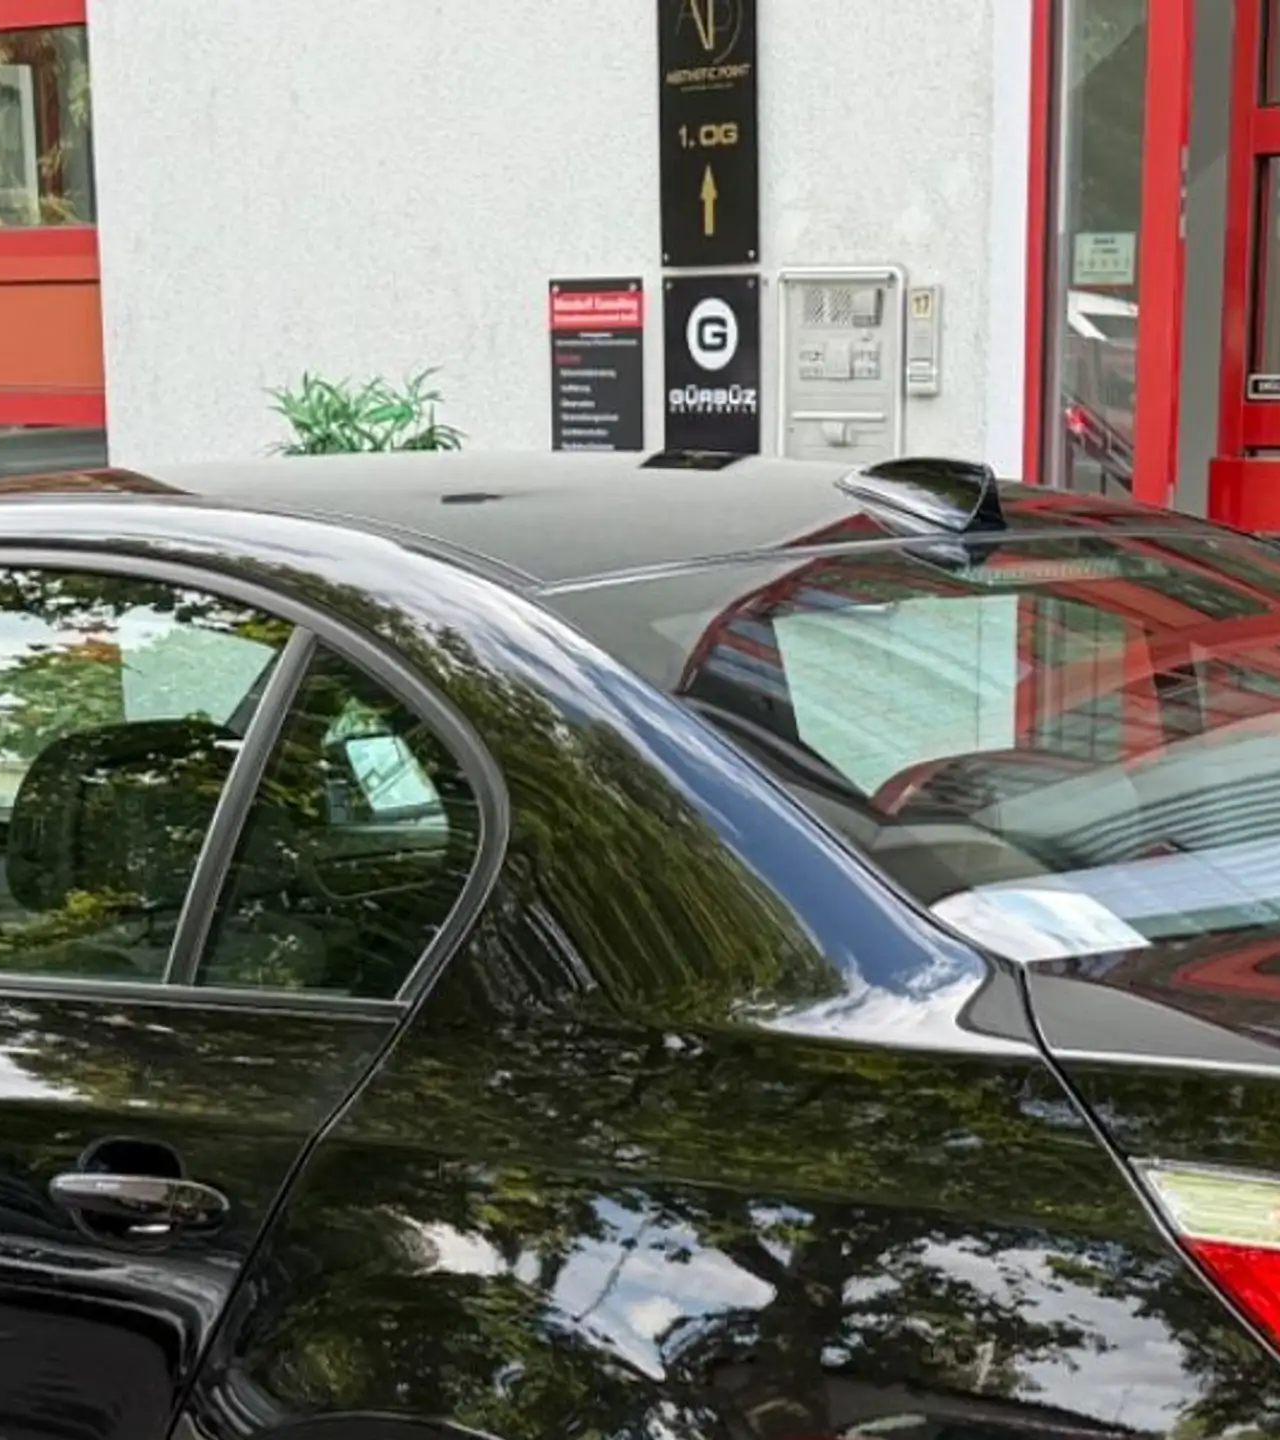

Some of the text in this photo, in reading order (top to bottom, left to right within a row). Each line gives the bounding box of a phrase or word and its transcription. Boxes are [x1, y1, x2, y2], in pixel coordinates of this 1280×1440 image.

[679, 121, 738, 149] 1. OG
[696, 316, 728, 352] G
[669, 384, 757, 405] GÜRBÜZ
